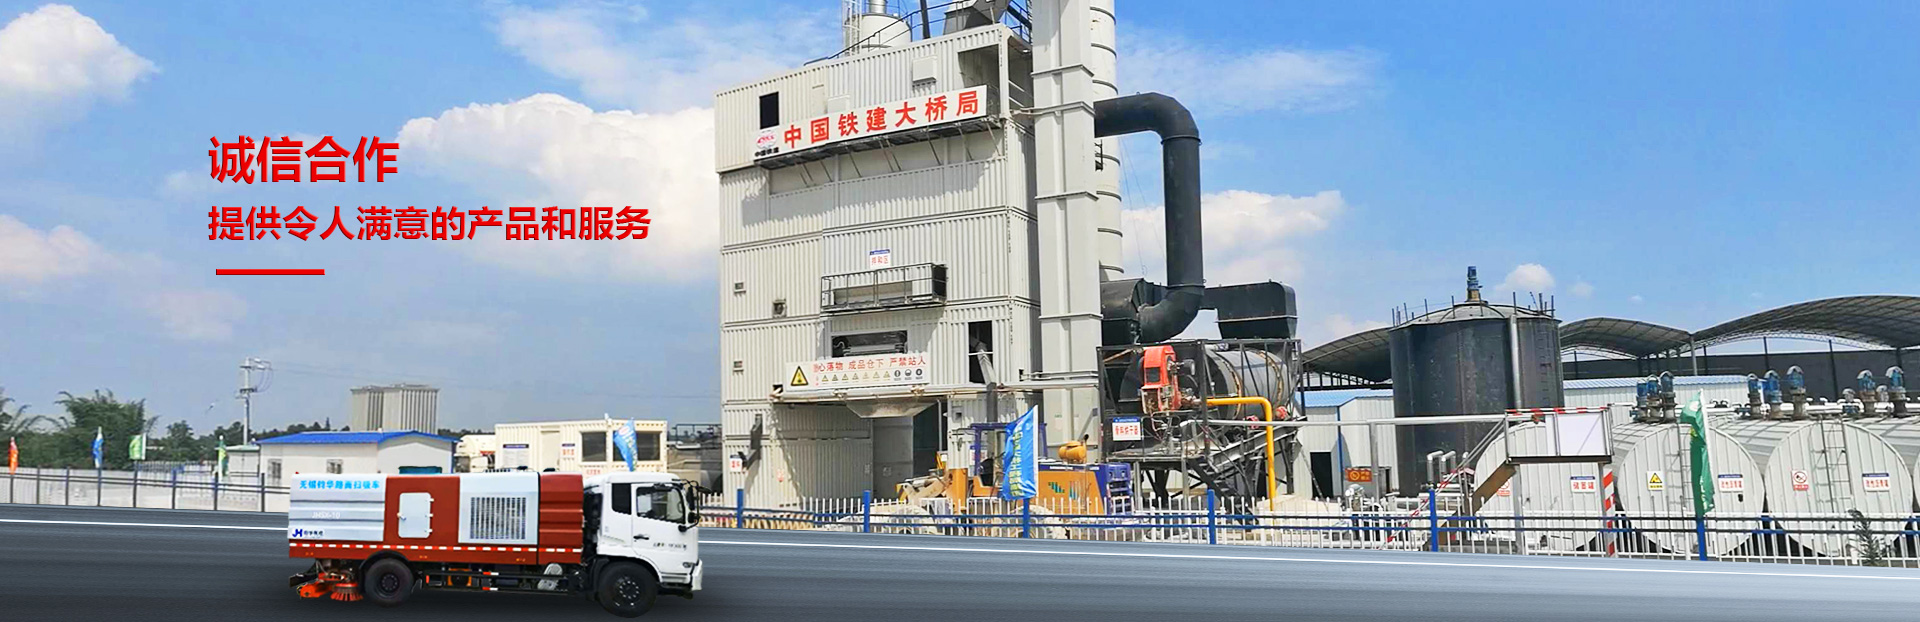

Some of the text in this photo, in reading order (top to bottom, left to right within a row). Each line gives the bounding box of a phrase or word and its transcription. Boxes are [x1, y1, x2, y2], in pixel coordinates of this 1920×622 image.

[784, 90, 979, 149] 中国铁建大桥局
[848, 358, 884, 370] 成品仓下
[889, 356, 926, 367] 严禁站人
